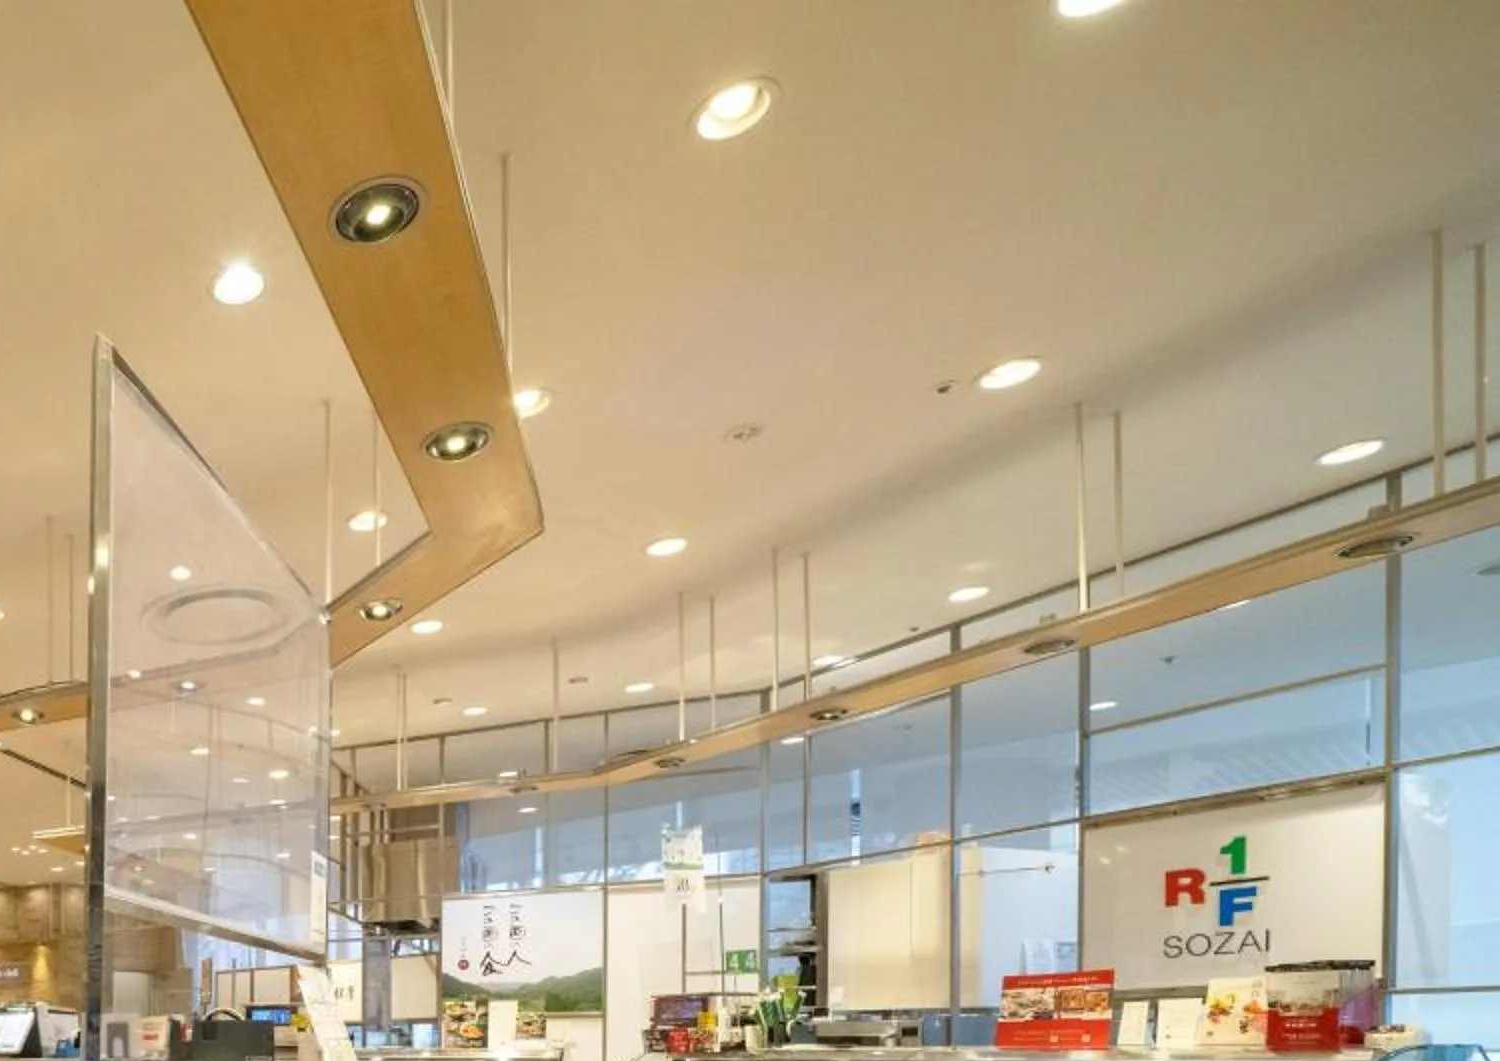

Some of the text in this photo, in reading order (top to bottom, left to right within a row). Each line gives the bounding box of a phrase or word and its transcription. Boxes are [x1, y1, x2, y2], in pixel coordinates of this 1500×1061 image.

[1219, 835, 1247, 875] 1
[1164, 867, 1206, 907] R
[1218, 886, 1258, 927] F
[1163, 928, 1270, 960] SOZAI
